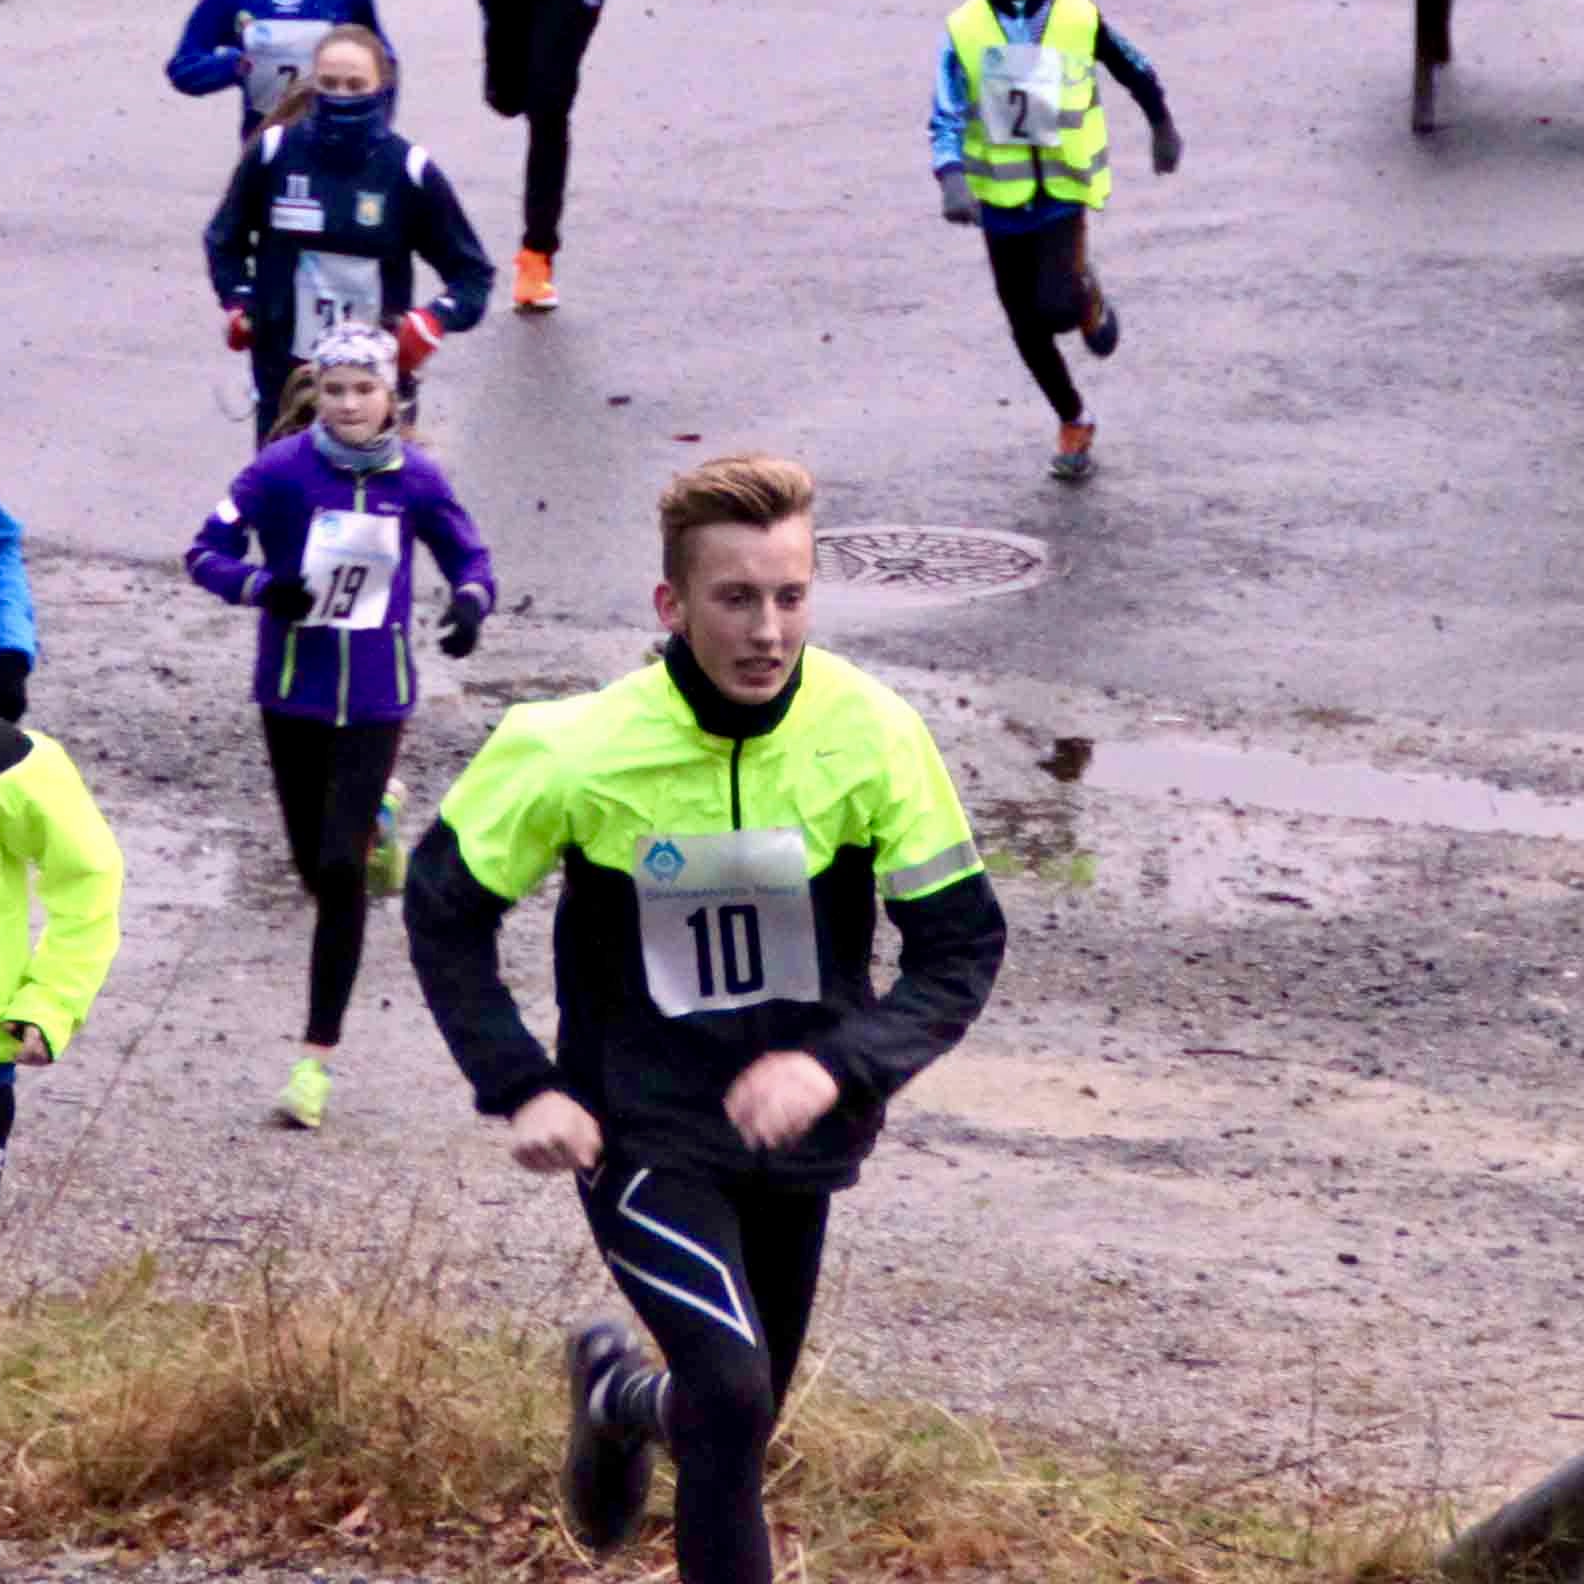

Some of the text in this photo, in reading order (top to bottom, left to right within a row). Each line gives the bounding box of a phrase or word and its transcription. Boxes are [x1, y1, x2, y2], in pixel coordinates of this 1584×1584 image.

[1008, 89, 1029, 138] 2
[319, 564, 369, 619] 19
[685, 903, 764, 997] 10
